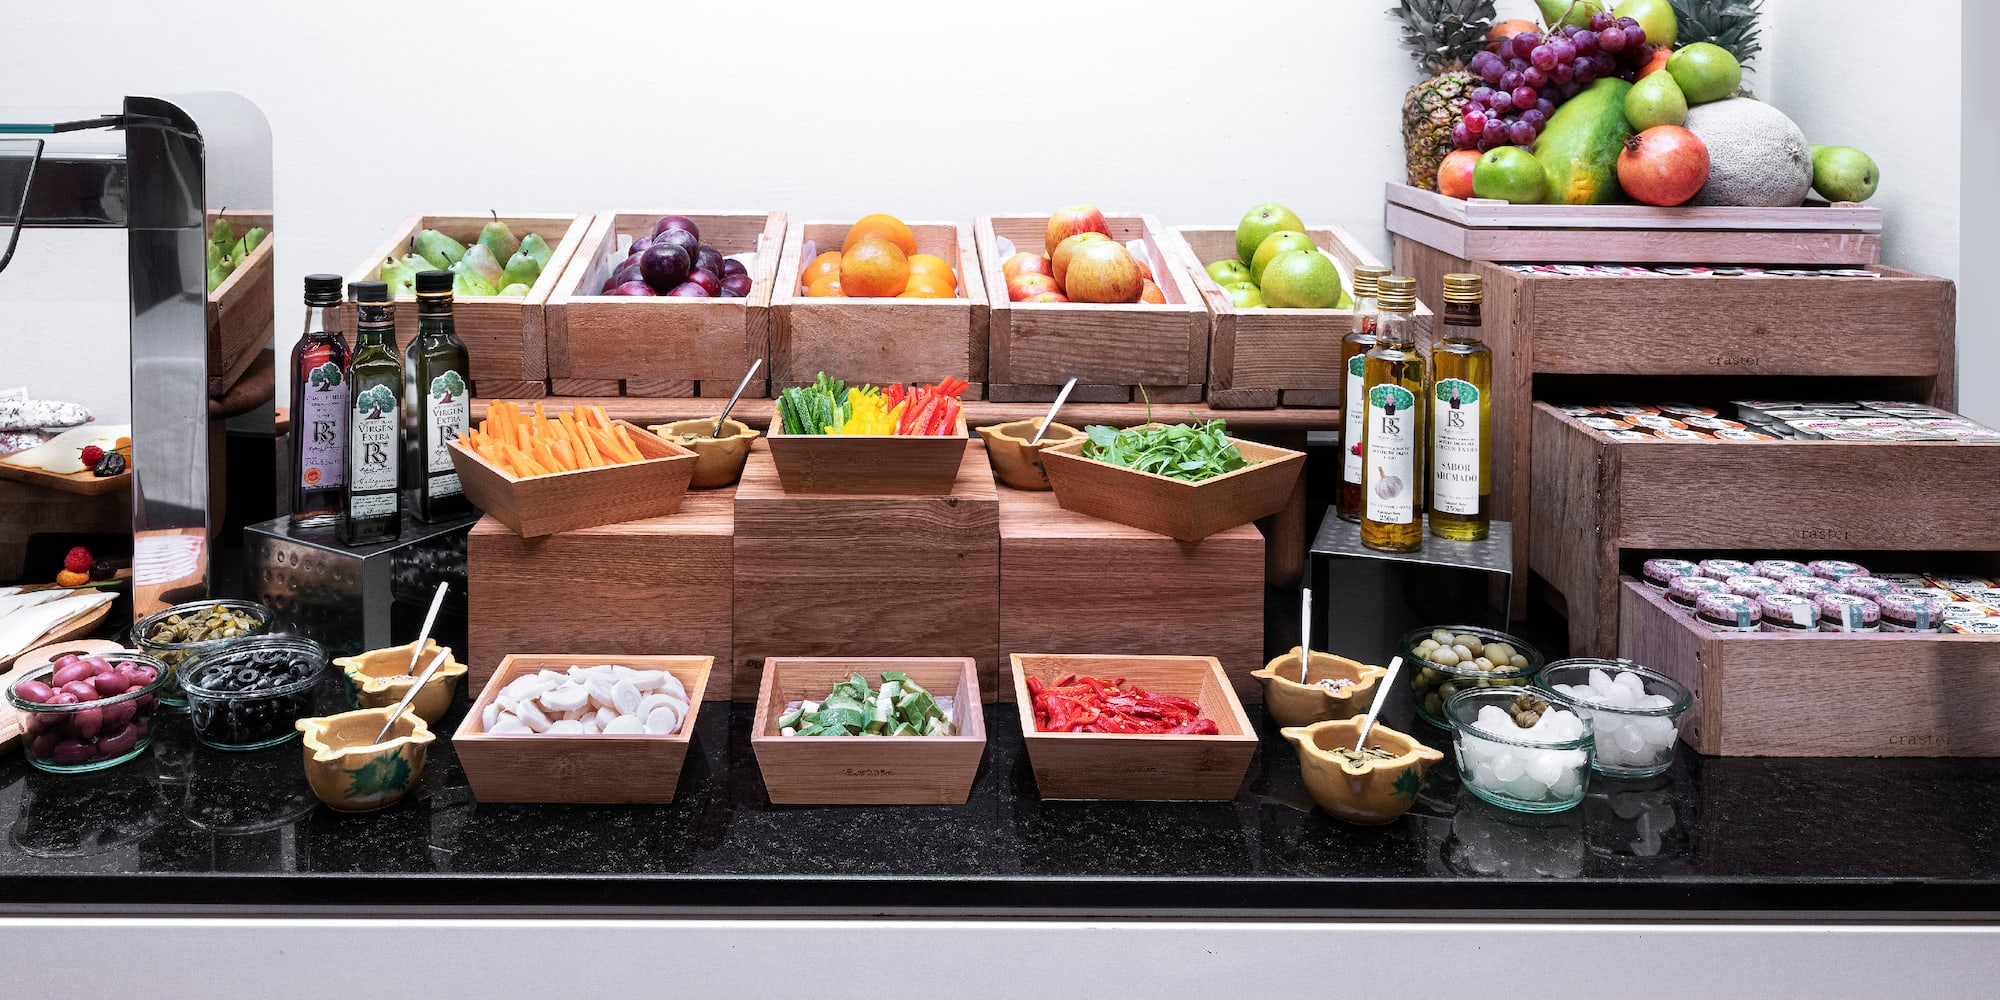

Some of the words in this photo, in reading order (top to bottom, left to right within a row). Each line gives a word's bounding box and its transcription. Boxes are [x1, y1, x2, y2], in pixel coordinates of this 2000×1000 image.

[1708, 354, 1762, 367] craster
[432, 407, 464, 417] VIRGEN
[436, 416, 461, 425] EXTRA
[358, 425, 394, 433] VIRGEN
[362, 433, 390, 441] EXTRA
[1441, 461, 1471, 472] SABOR
[1436, 471, 1478, 482] AHUMADO
[1888, 733, 1951, 746] craster
